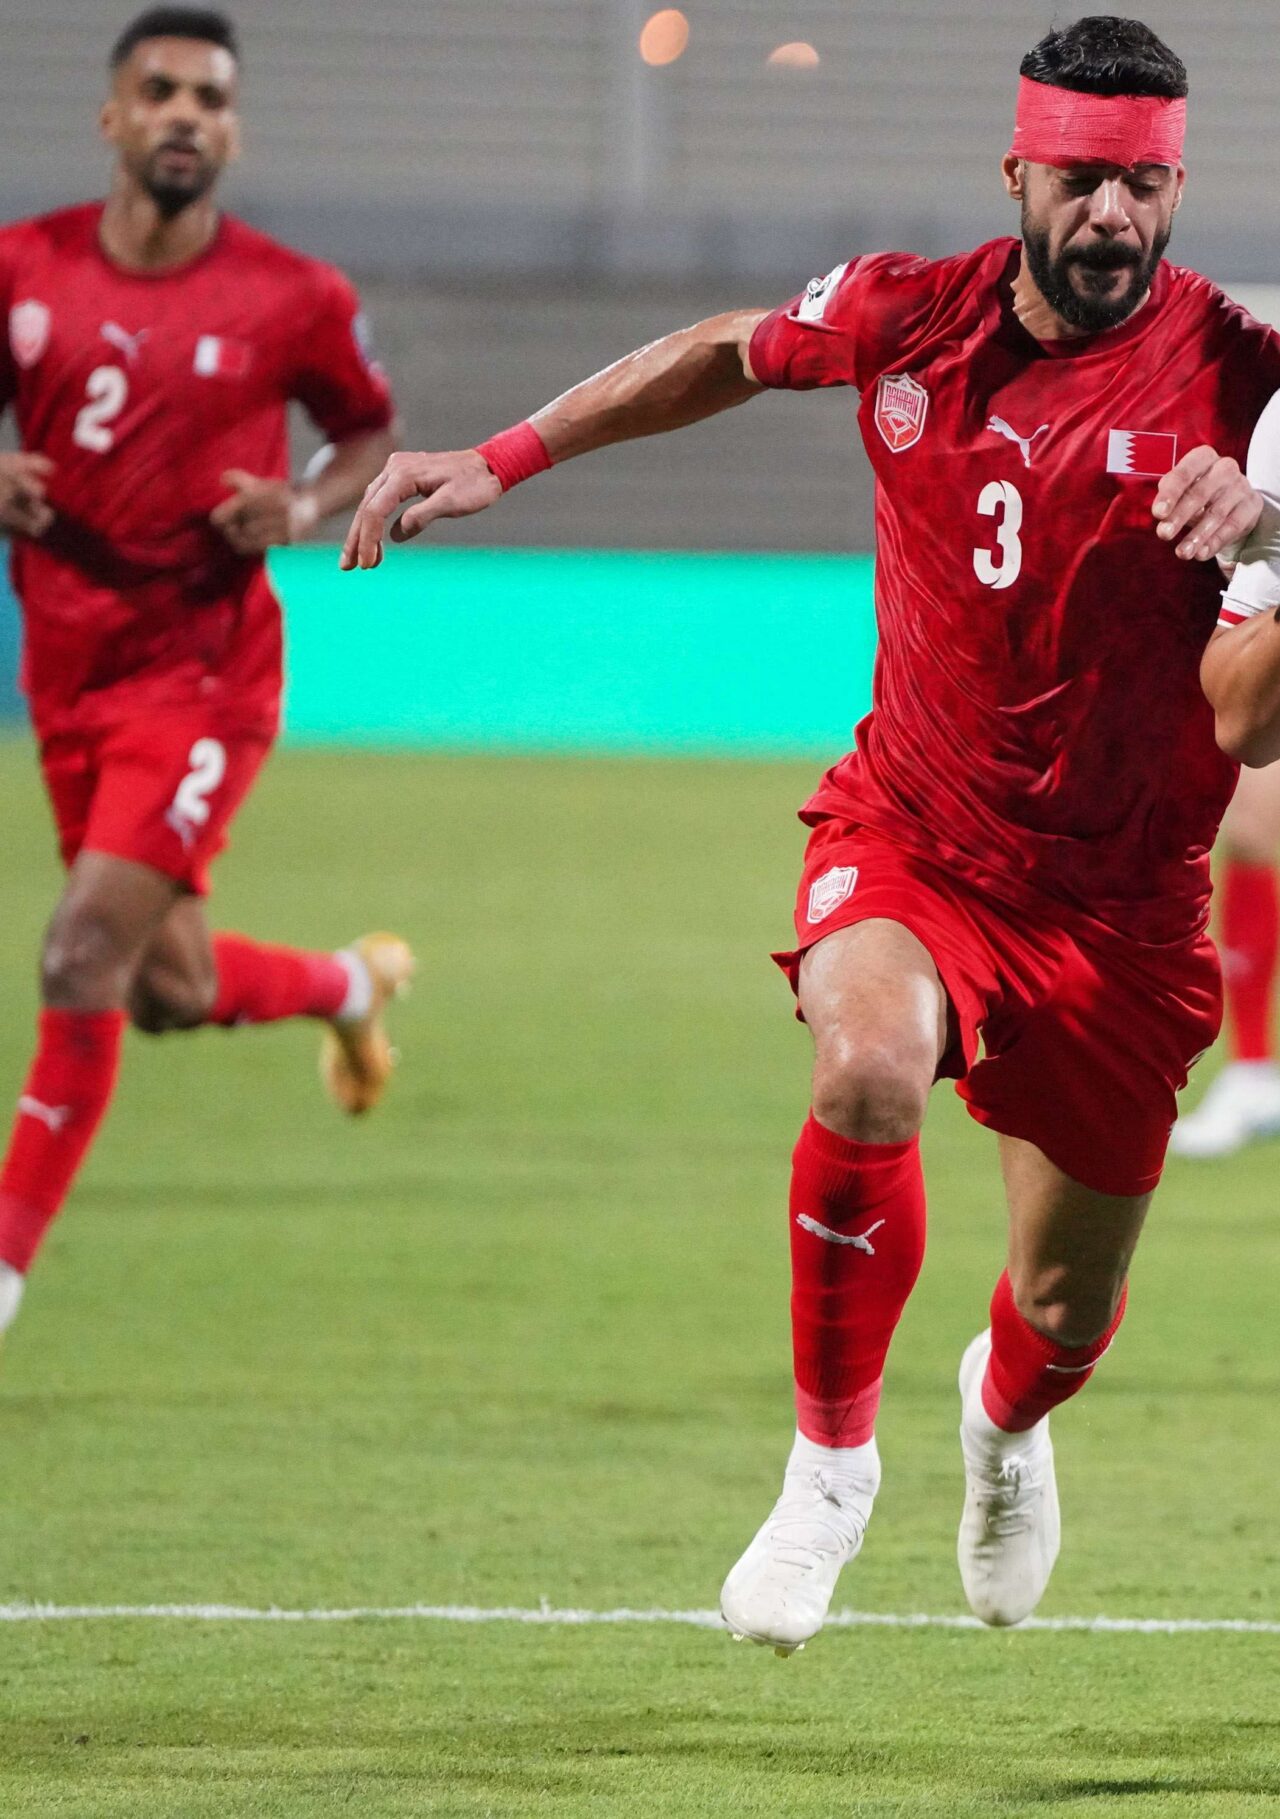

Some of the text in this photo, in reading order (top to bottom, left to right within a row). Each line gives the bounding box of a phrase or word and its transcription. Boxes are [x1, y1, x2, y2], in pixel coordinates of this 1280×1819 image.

[73, 365, 128, 454] 2
[973, 479, 1023, 589] 3
[172, 737, 227, 825] 2
